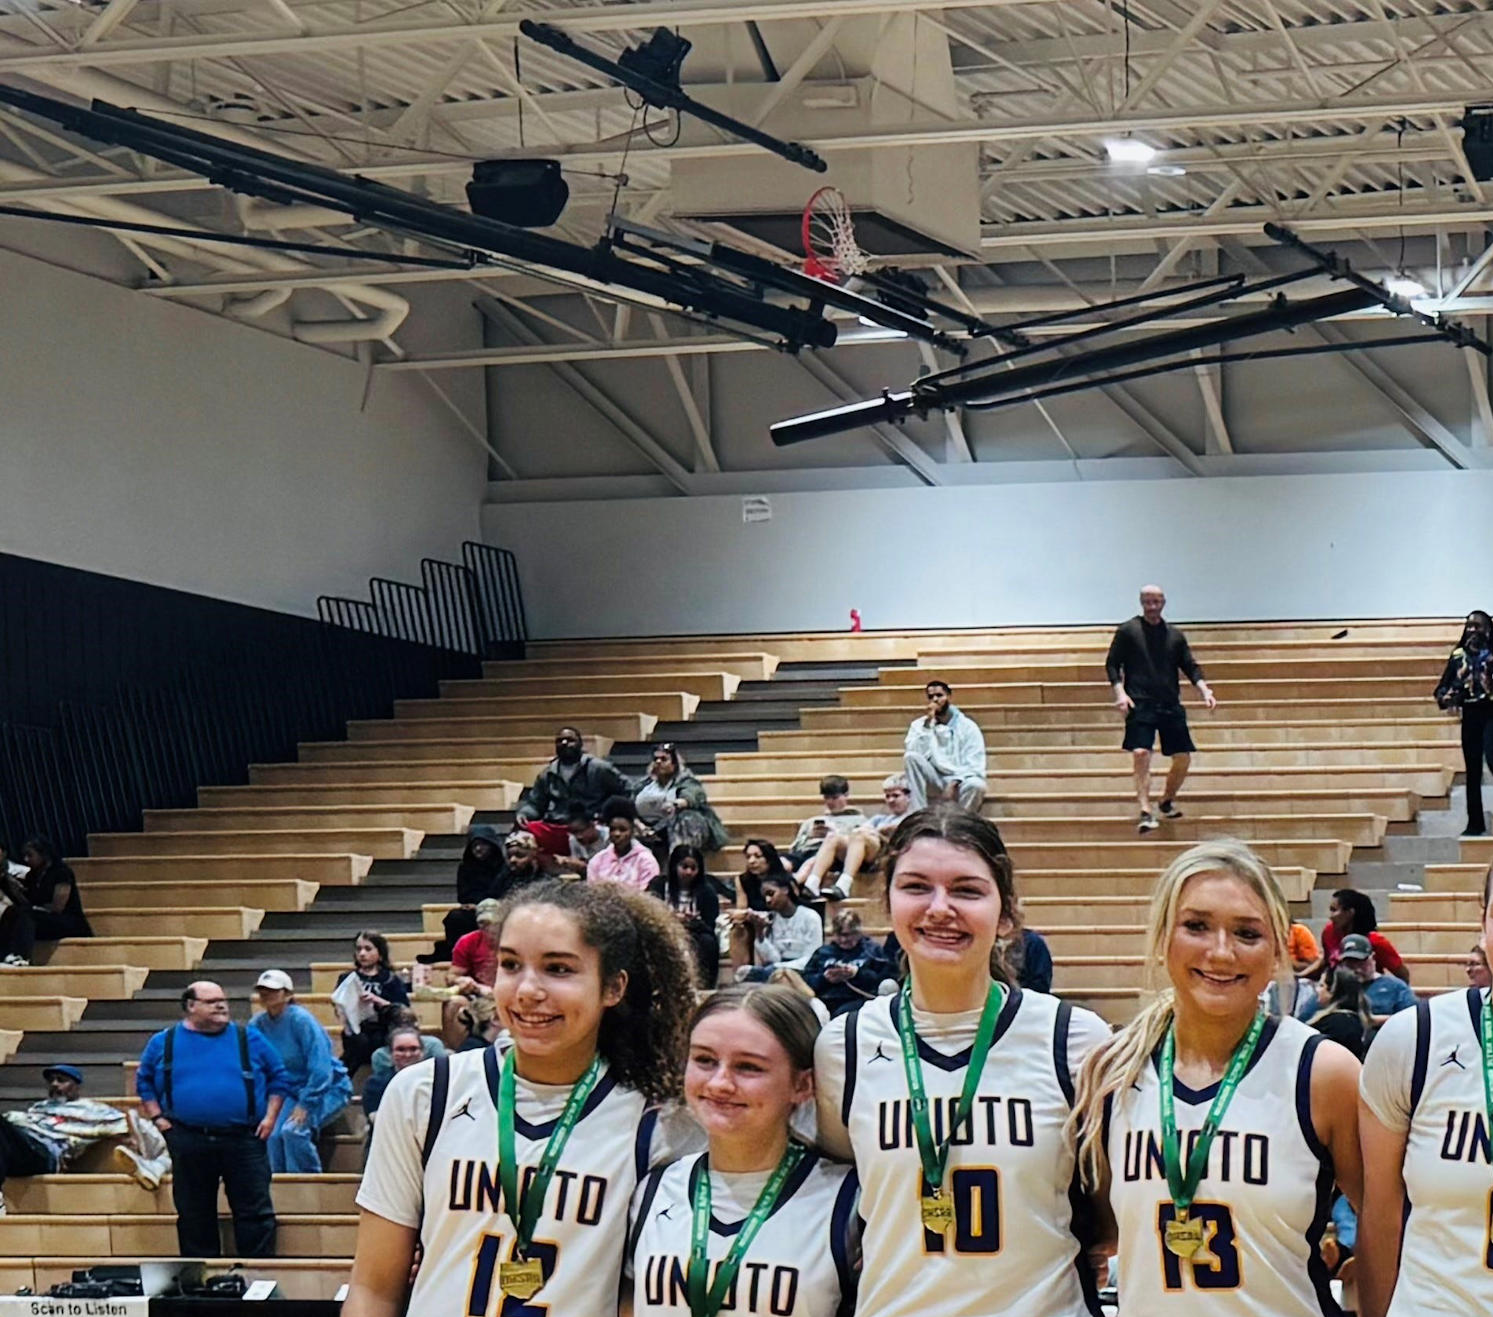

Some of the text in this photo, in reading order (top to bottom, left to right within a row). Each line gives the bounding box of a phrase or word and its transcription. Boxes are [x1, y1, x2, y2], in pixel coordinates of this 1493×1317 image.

[1124, 1130, 1269, 1185] UNOTO
[449, 1159, 607, 1226] UNOTO
[917, 1165, 1004, 1258] 10
[1156, 1200, 1244, 1293] 13
[31, 1302, 127, 1315] Scan to Listen
[646, 1255, 799, 1317] UNOTO
